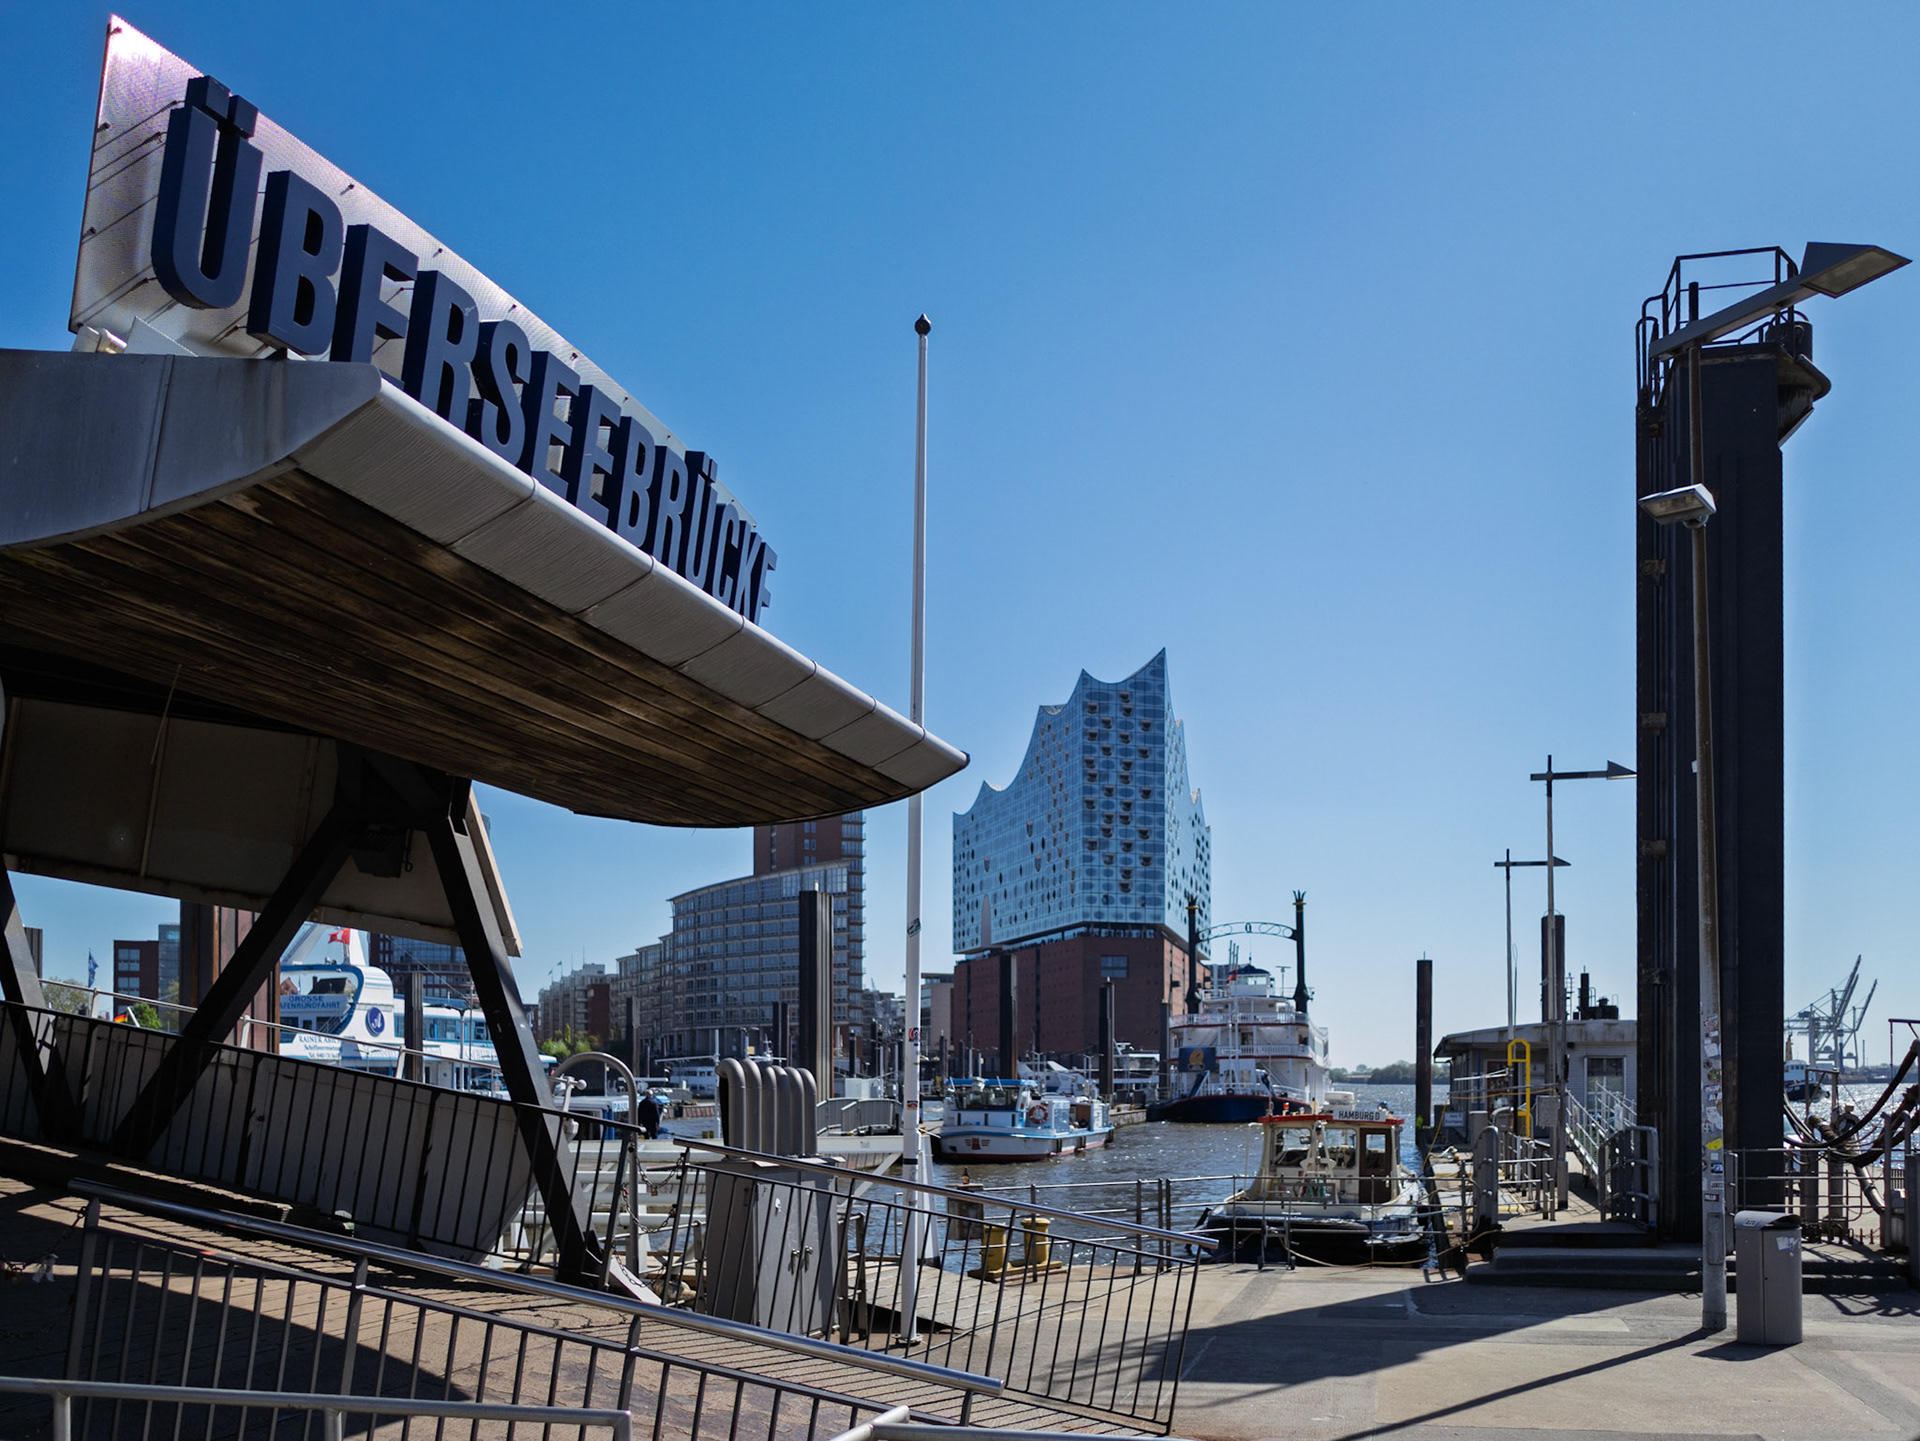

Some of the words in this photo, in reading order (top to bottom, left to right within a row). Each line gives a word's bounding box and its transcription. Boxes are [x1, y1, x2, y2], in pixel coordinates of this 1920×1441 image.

[151, 75, 778, 626] ÜBERSEEBRÜCKE
[288, 995, 324, 1003] GROSSE
[280, 1001, 340, 1010] AFENRUNDFAHRT
[1338, 1110, 1374, 1121] HAMBURG
